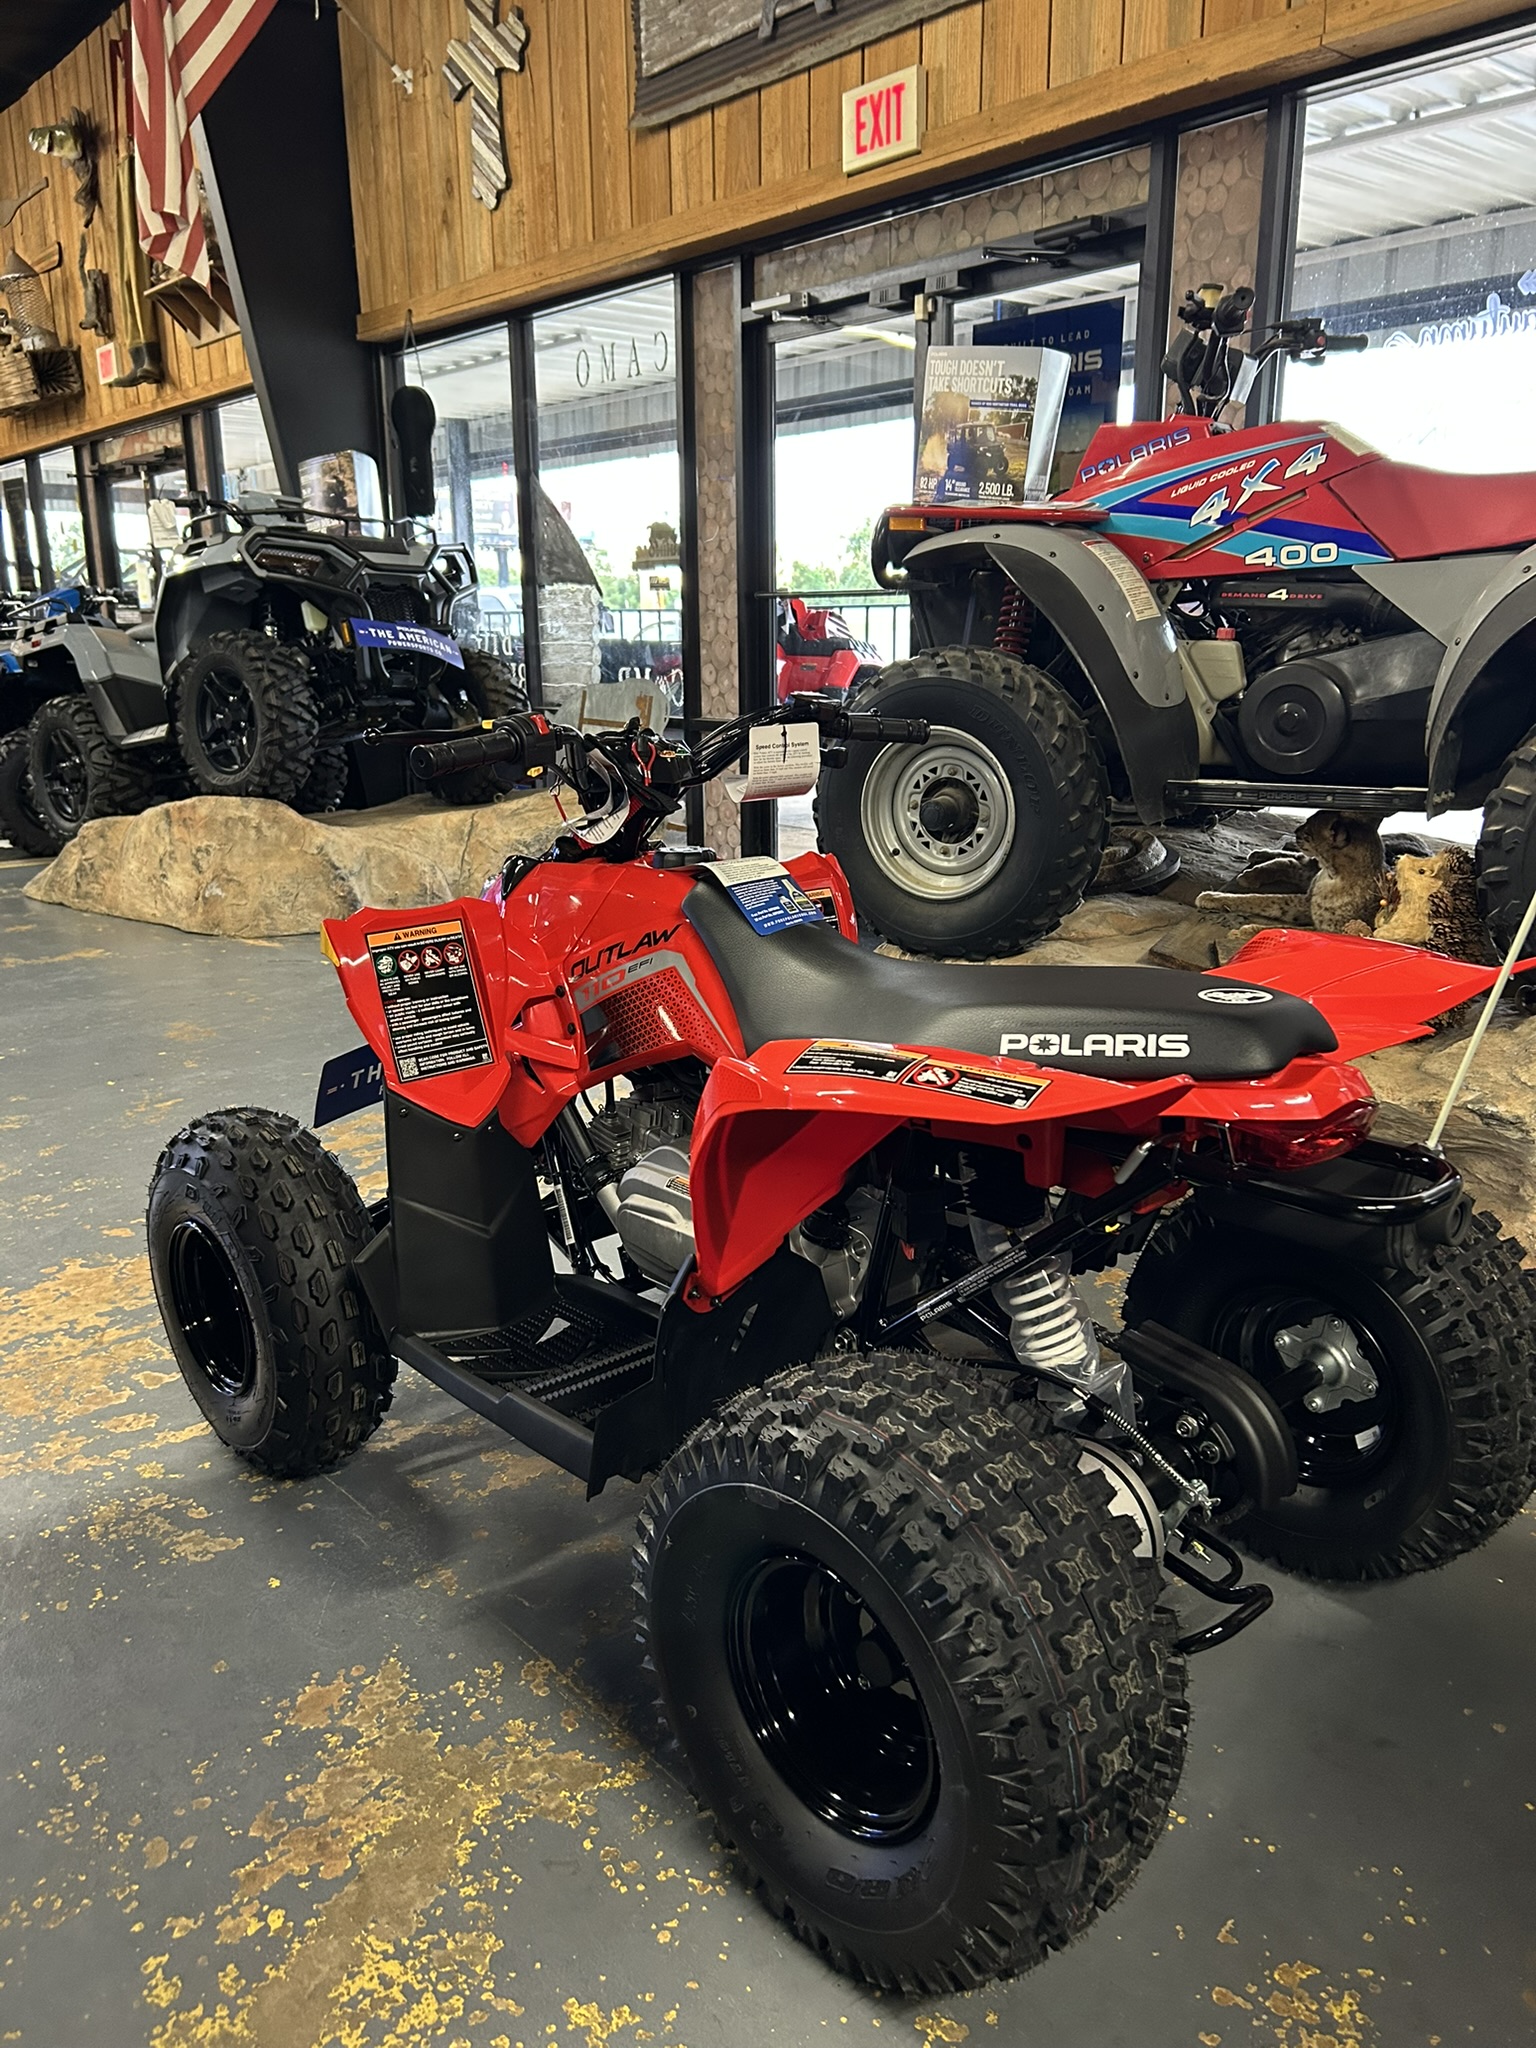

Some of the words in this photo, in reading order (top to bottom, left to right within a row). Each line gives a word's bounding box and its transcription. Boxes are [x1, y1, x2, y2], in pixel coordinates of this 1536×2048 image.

[855, 82, 906, 155] EXIT
[1041, 335, 1054, 345] TO
[1061, 329, 1090, 343] LEAD
[930, 360, 959, 375] TOUGH
[960, 360, 1006, 376] DOESN'T
[1071, 349, 1103, 373] RIS
[929, 376, 951, 392] TAKE
[951, 376, 1013, 394] SHORTCUTS
[1068, 384, 1091, 396] OAM
[1079, 427, 1192, 483] POLARIS
[928, 477, 938, 491] HP
[978, 481, 1001, 496] 2,500
[1001, 484, 1014, 497] LB.
[1170, 475, 1207, 498] LIQUID
[1208, 459, 1256, 483] COOLED
[1244, 542, 1339, 568] 400
[368, 627, 395, 639] THE
[398, 631, 453, 655] AMERICAN
[387, 639, 434, 653] POWERSPORTS
[1258, 791, 1308, 801] POLARIS
[808, 890, 825, 898] ARNING
[402, 926, 438, 940] WARNING
[571, 923, 683, 980] OUTLAW
[581, 969, 626, 1001] 110
[627, 957, 654, 974] EFI
[999, 1033, 1191, 1058] POLARIS
[351, 1062, 383, 1089] TH
[919, 1300, 953, 1322] POLARIS
